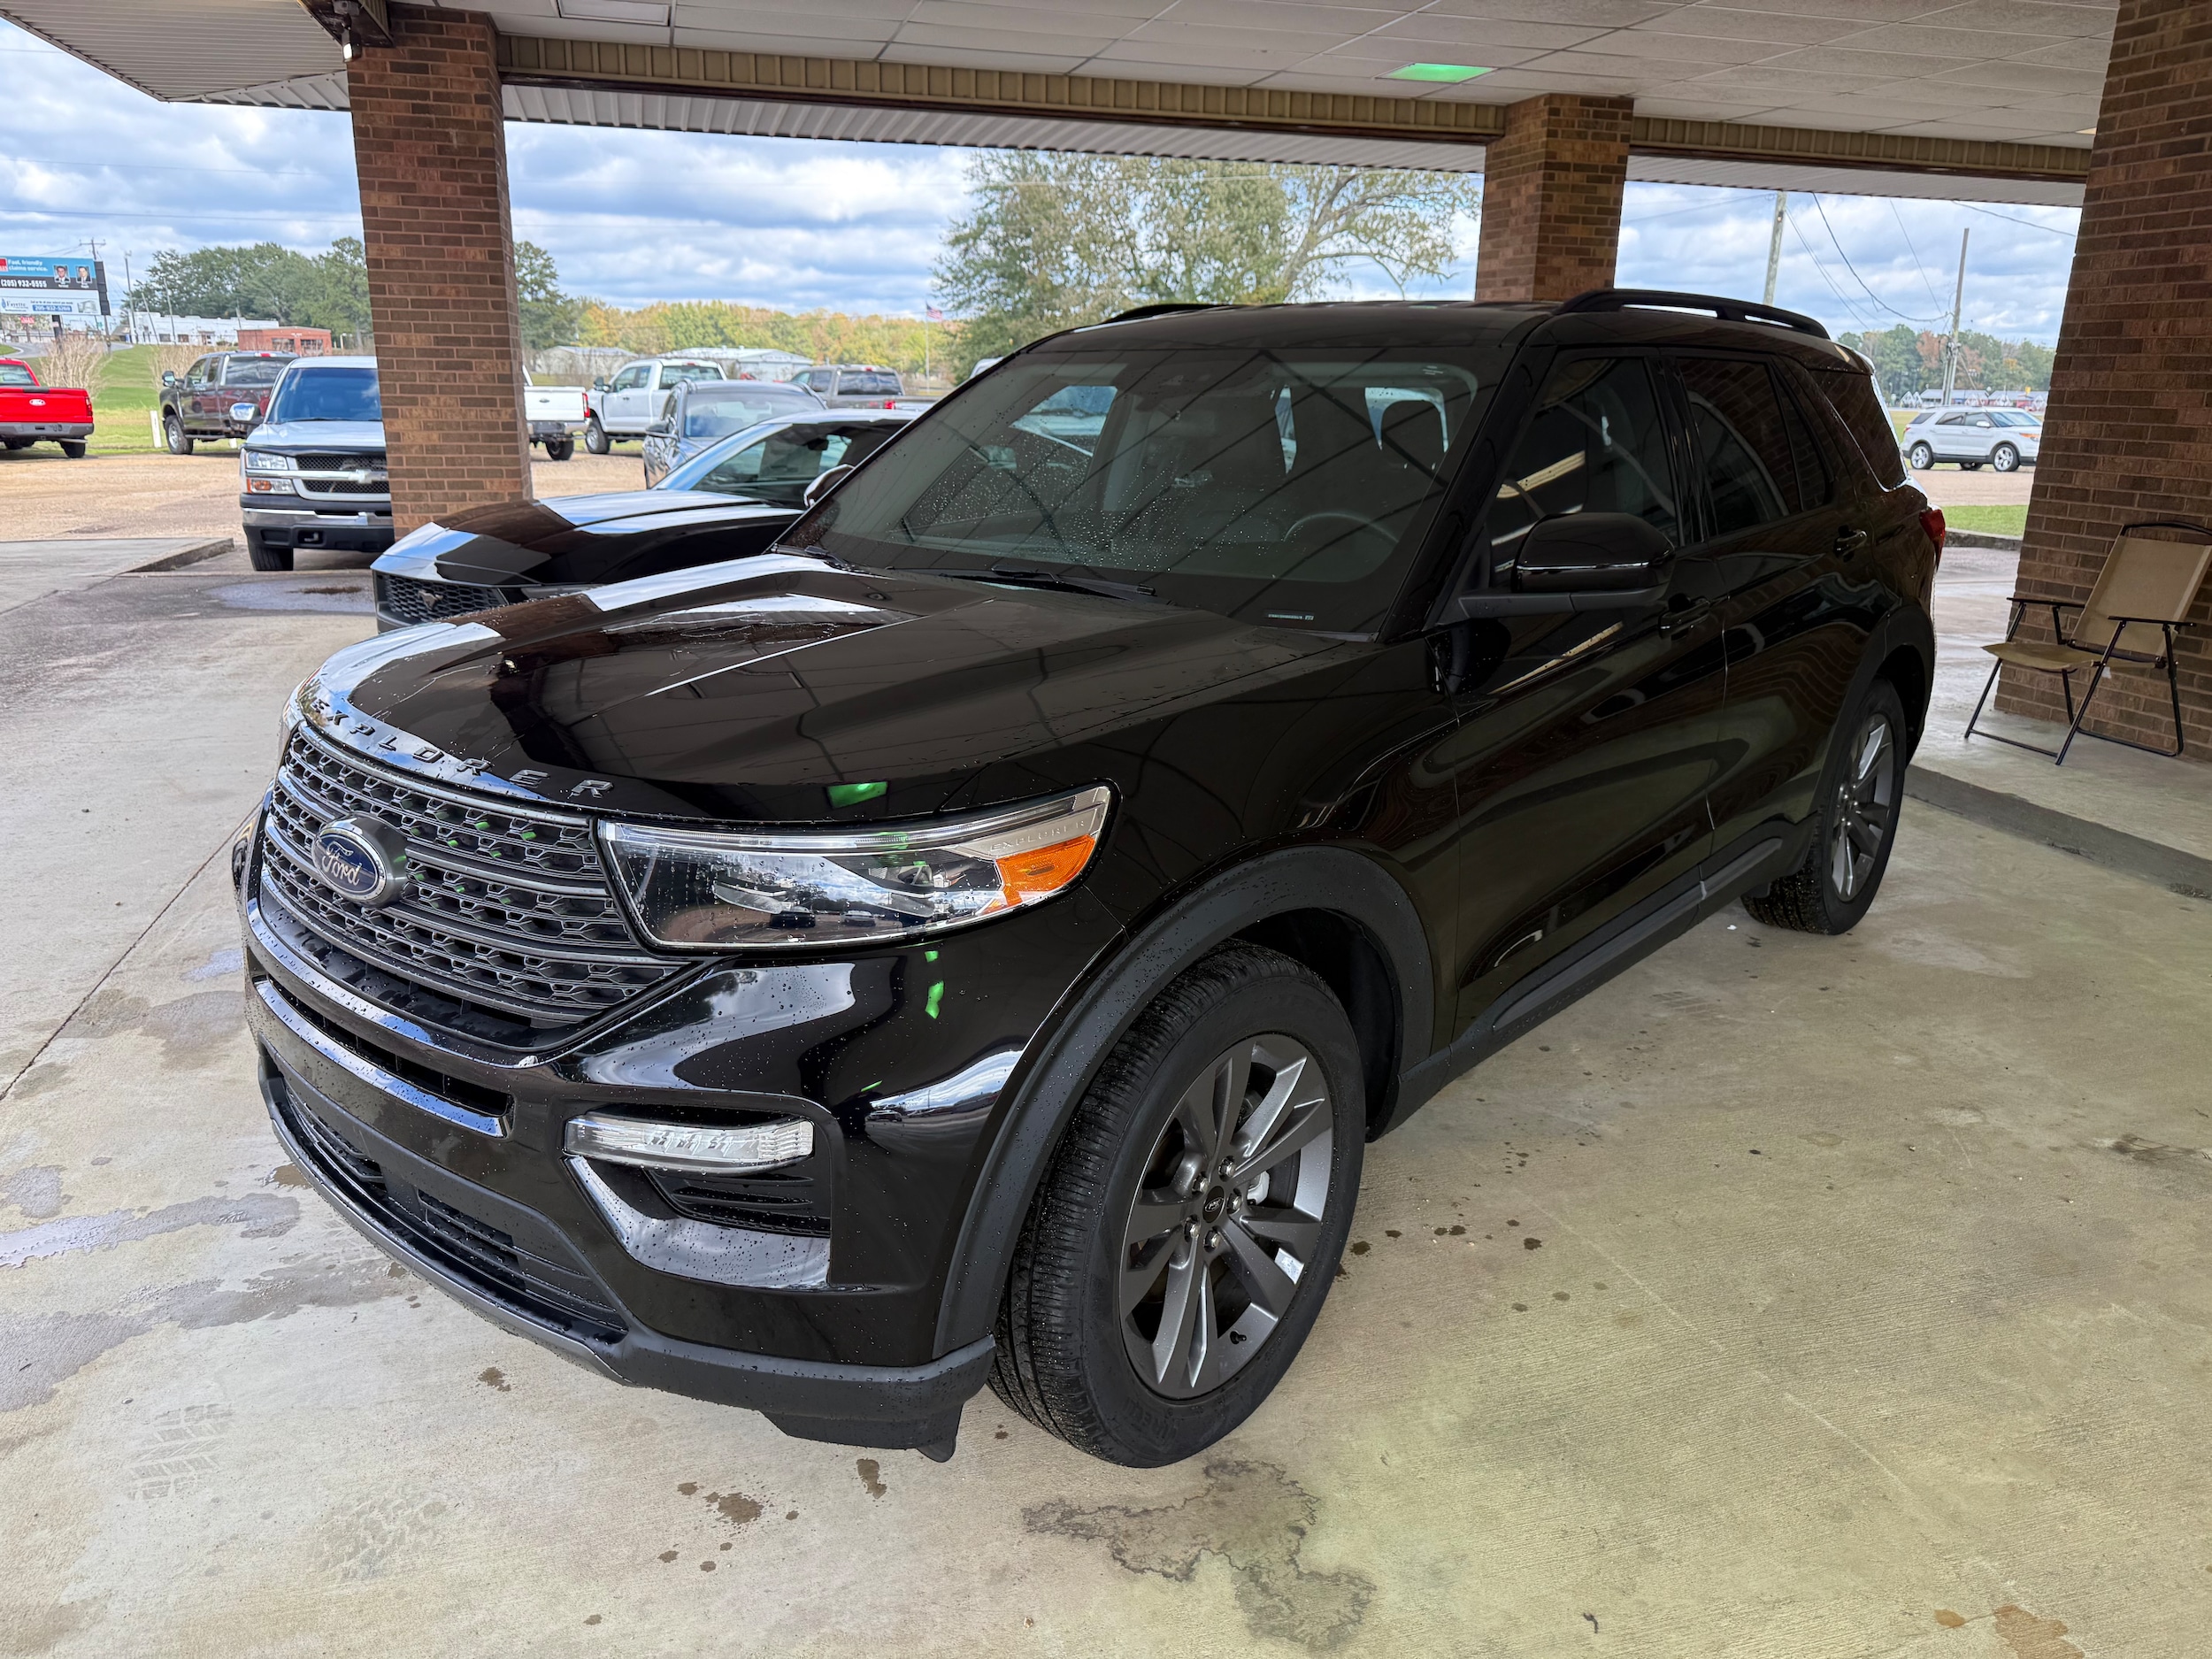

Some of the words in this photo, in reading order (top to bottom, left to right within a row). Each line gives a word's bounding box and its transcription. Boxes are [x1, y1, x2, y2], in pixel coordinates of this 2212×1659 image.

[1, 279, 17, 288] (205)
[18, 279, 47, 288] 932-5555
[310, 697, 615, 799] EXPLORER
[322, 841, 362, 886] Ford
